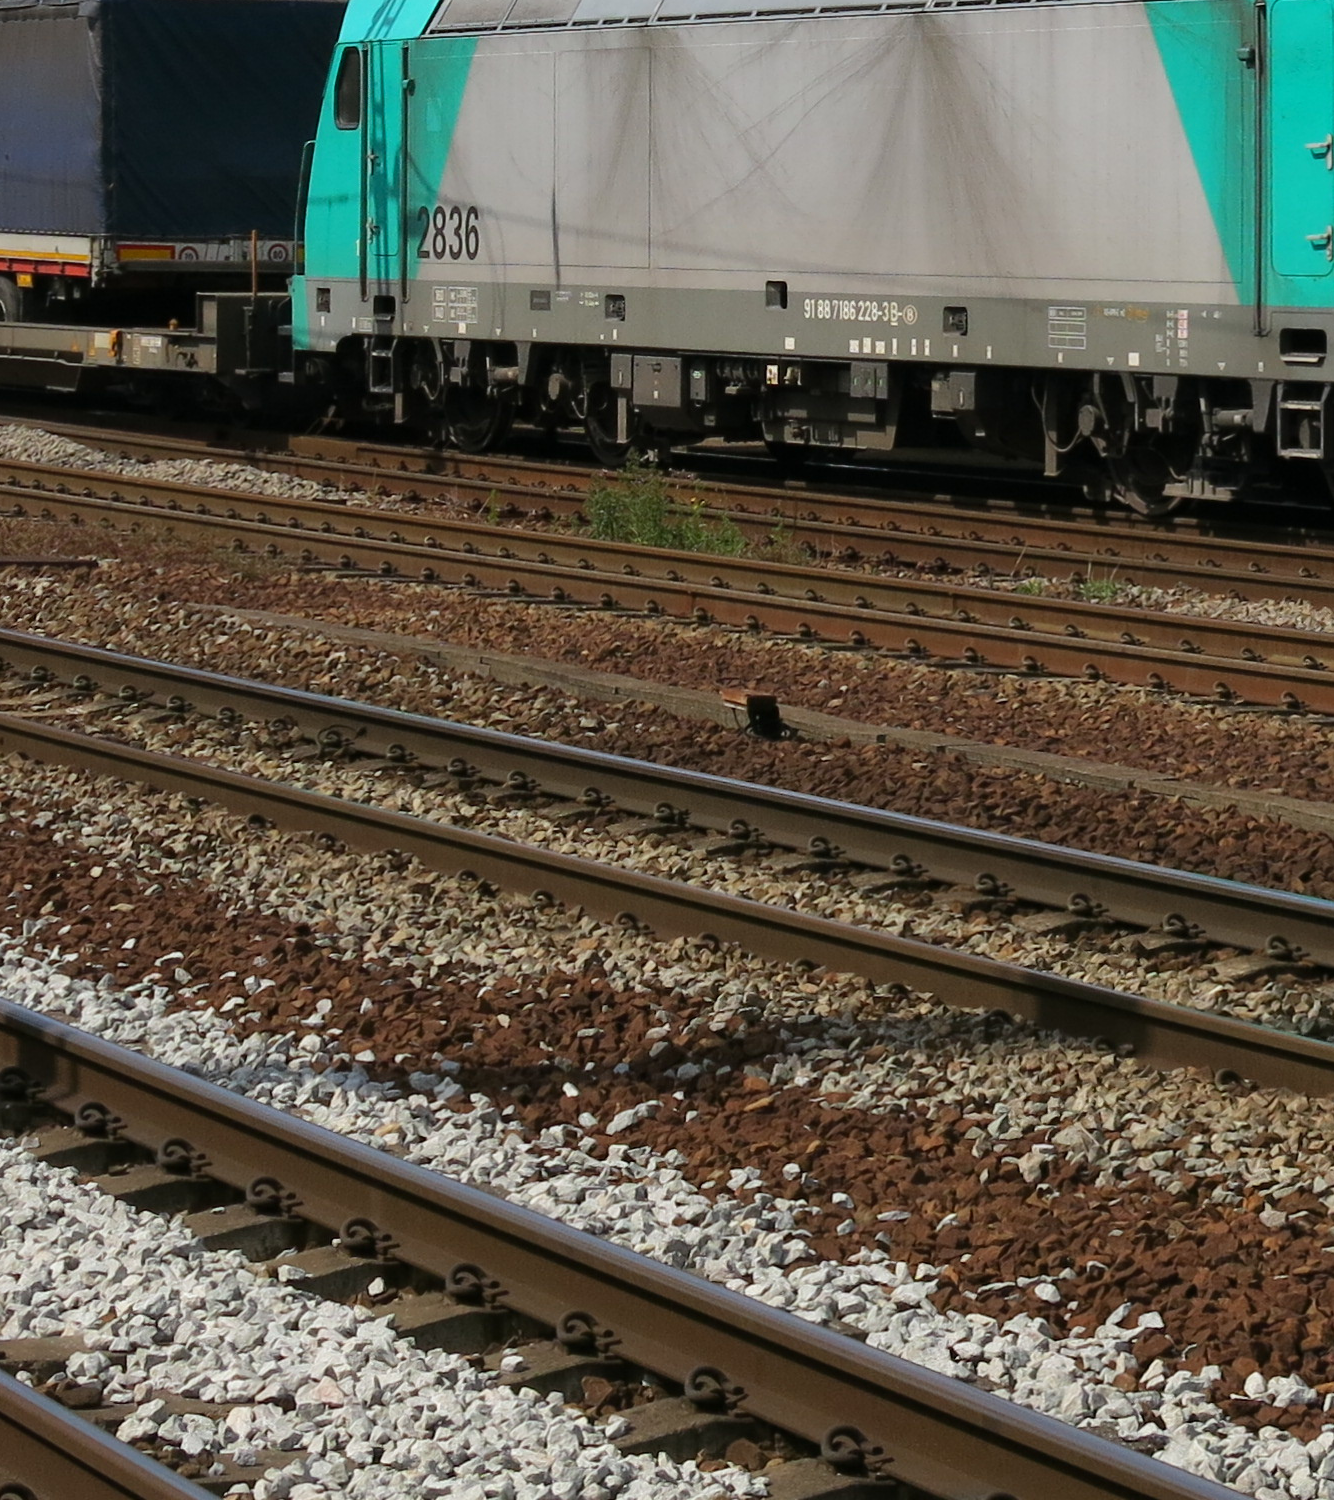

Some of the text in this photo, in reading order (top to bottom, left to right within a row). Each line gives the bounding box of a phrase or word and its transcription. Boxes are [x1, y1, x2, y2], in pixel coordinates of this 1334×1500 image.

[417, 205, 480, 261] 2836
[803, 298, 815, 319] 91
[816, 299, 831, 320] 88
